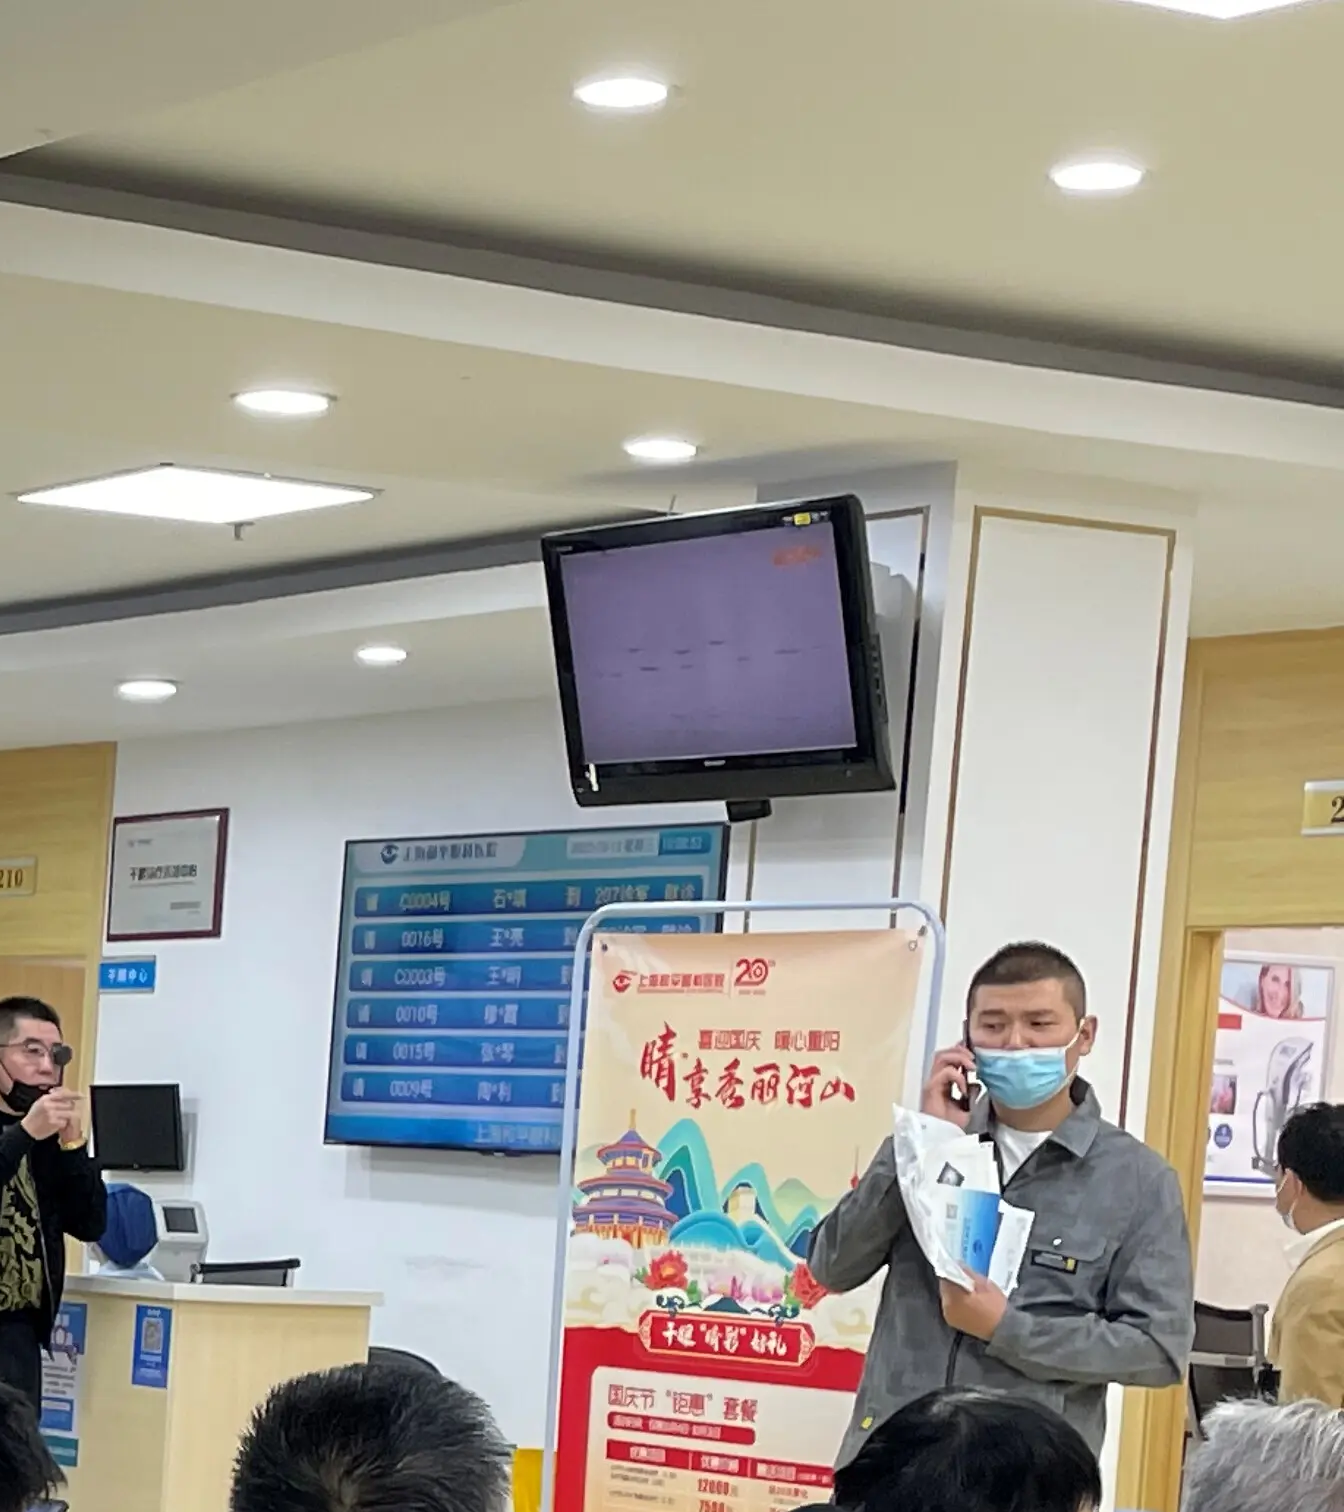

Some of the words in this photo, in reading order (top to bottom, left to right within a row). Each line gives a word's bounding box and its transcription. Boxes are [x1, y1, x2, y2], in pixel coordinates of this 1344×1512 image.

[698, 1029, 762, 1051] 喜迎国庆
[773, 1030, 841, 1052] 暖心重阳
